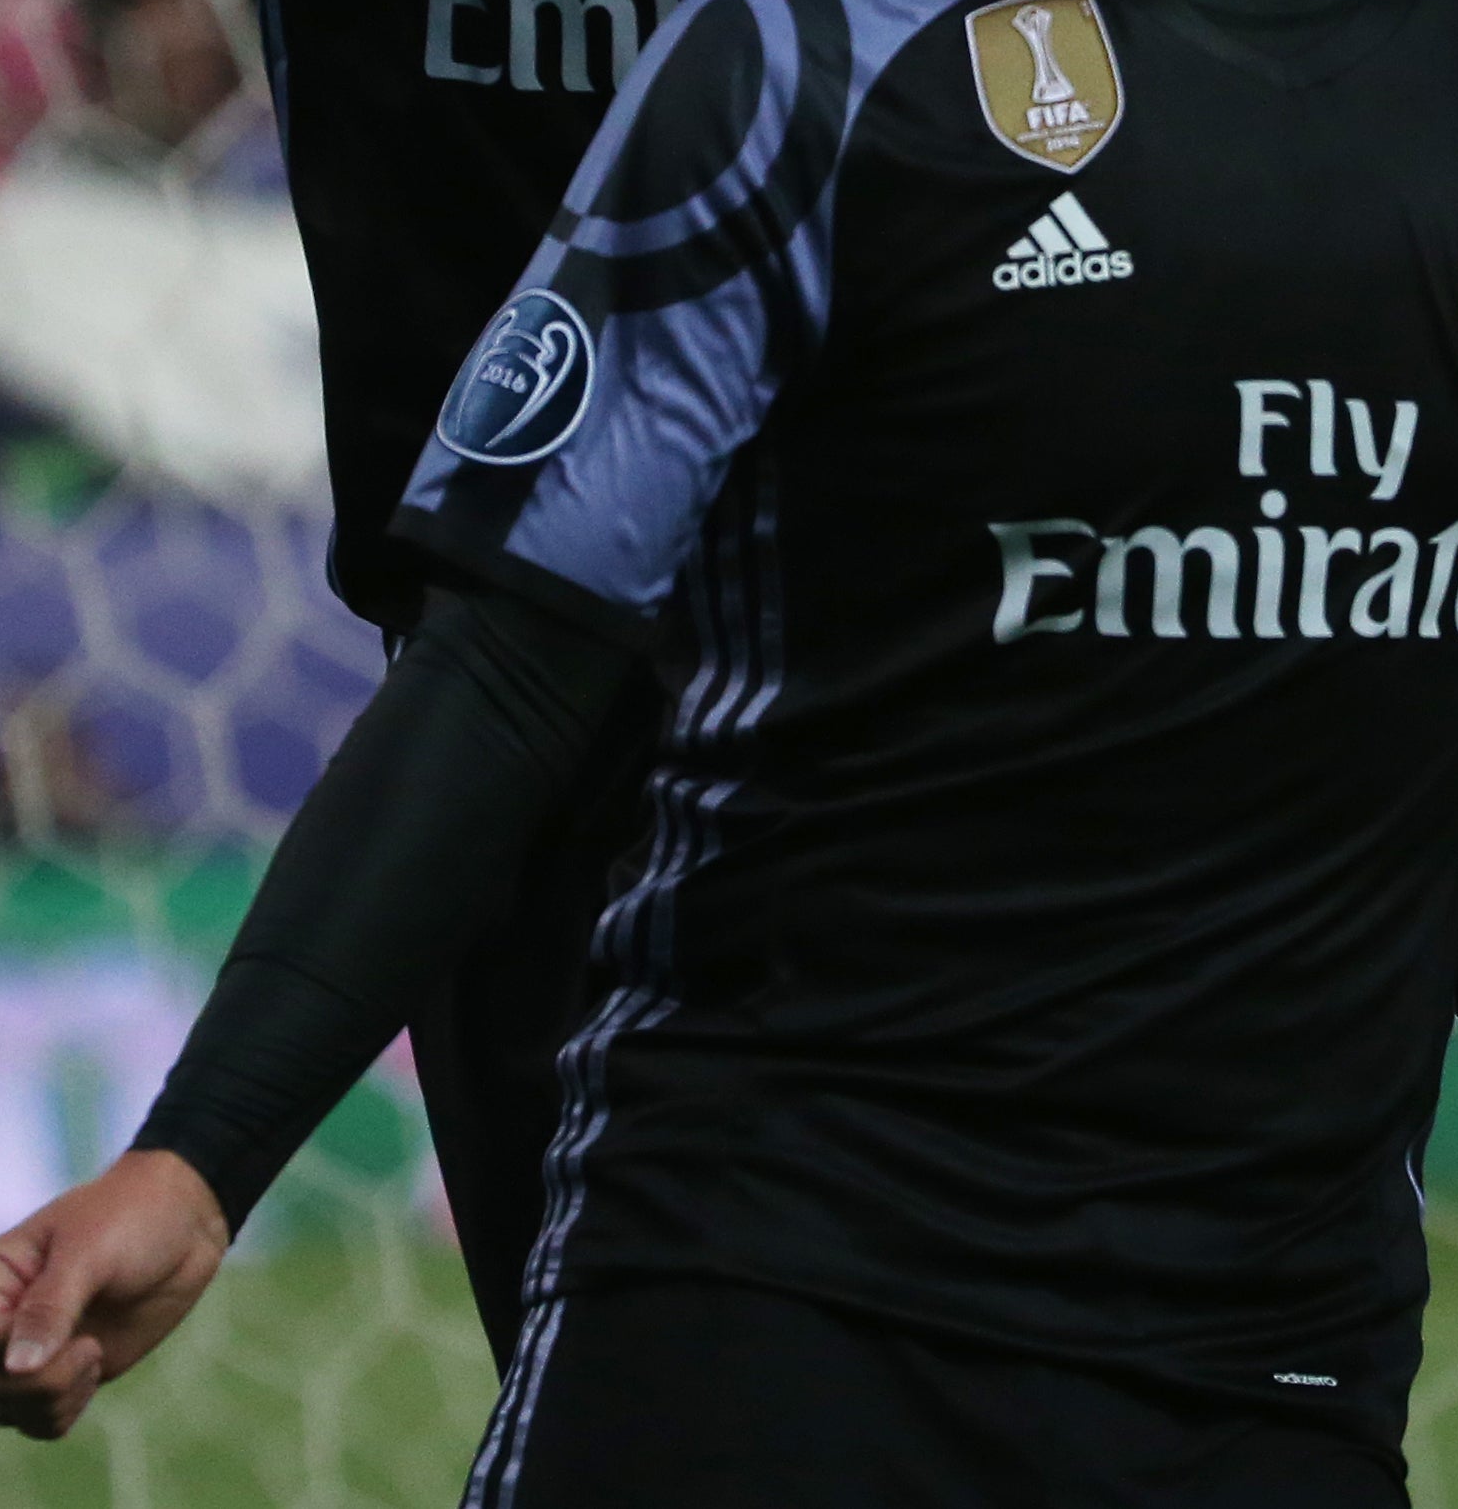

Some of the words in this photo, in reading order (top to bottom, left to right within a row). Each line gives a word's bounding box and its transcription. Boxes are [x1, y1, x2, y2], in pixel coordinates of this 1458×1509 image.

[1026, 100, 1091, 130] FIFA
[992, 247, 1134, 291] adidas
[1233, 379, 1420, 500] Fly
